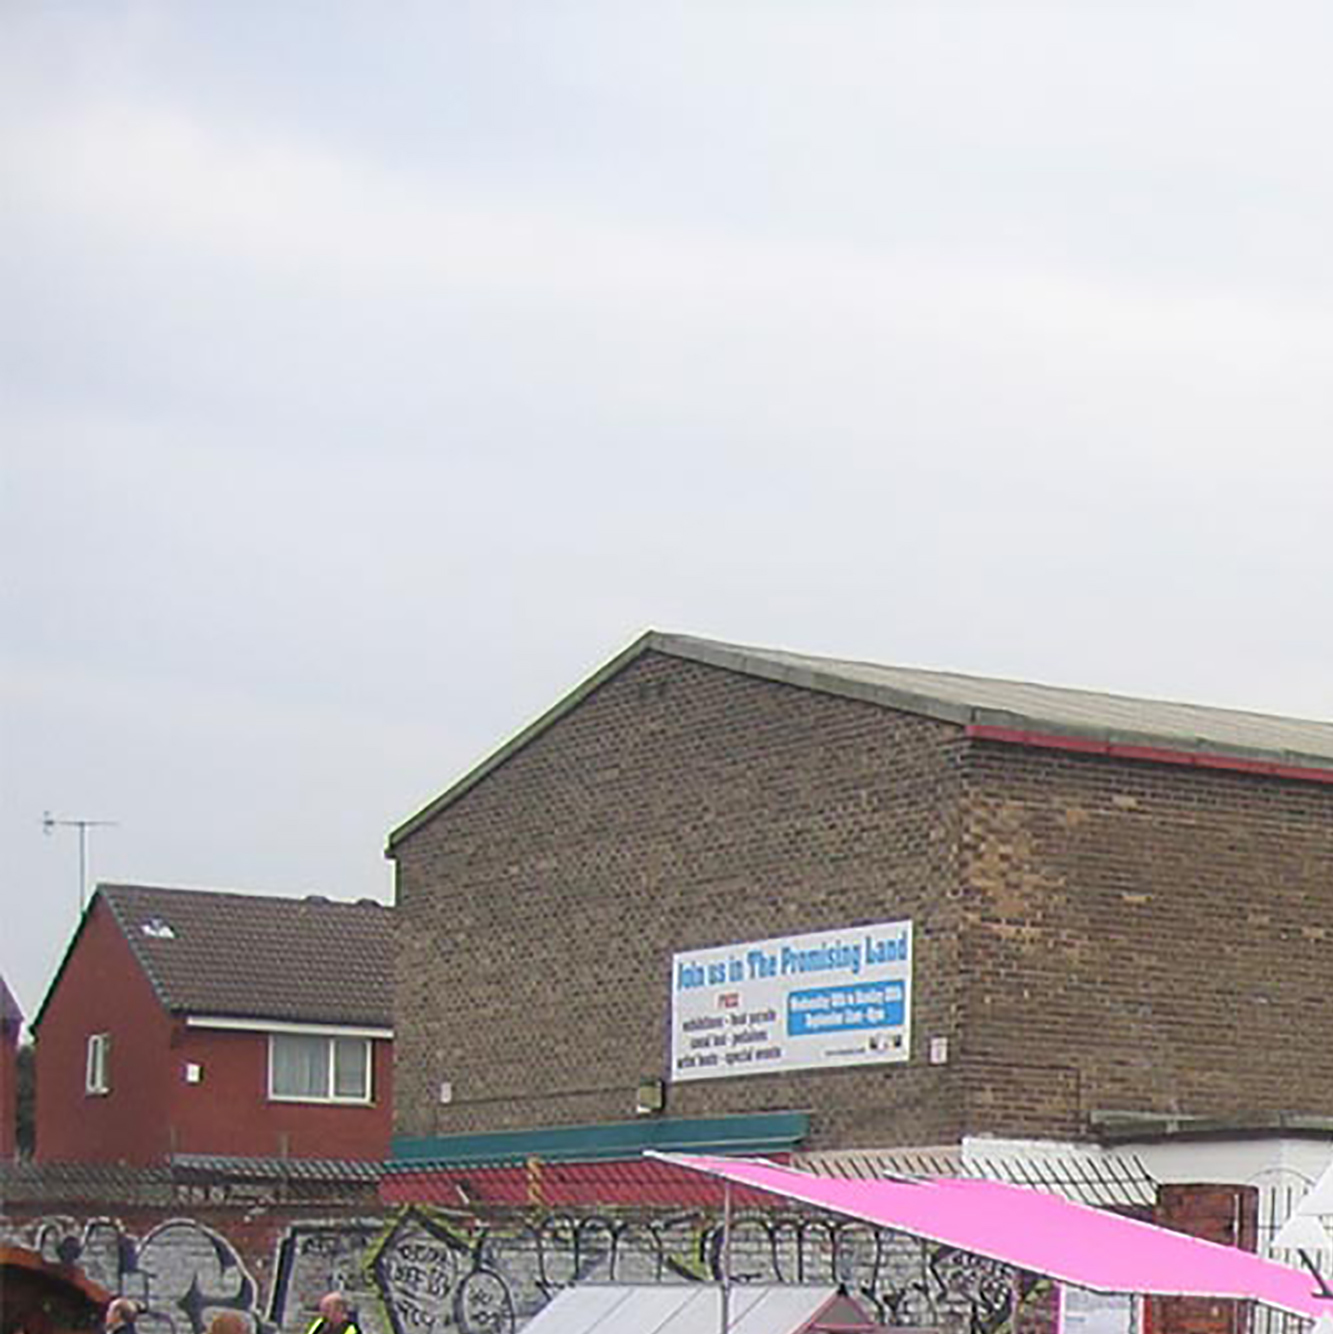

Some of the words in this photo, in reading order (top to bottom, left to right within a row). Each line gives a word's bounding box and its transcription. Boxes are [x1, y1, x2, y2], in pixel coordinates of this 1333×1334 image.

[676, 960, 705, 991] Join
[707, 962, 726, 985] us
[729, 956, 744, 982] in
[747, 950, 777, 979] The
[780, 939, 861, 975] Promising
[866, 931, 908, 964] Land
